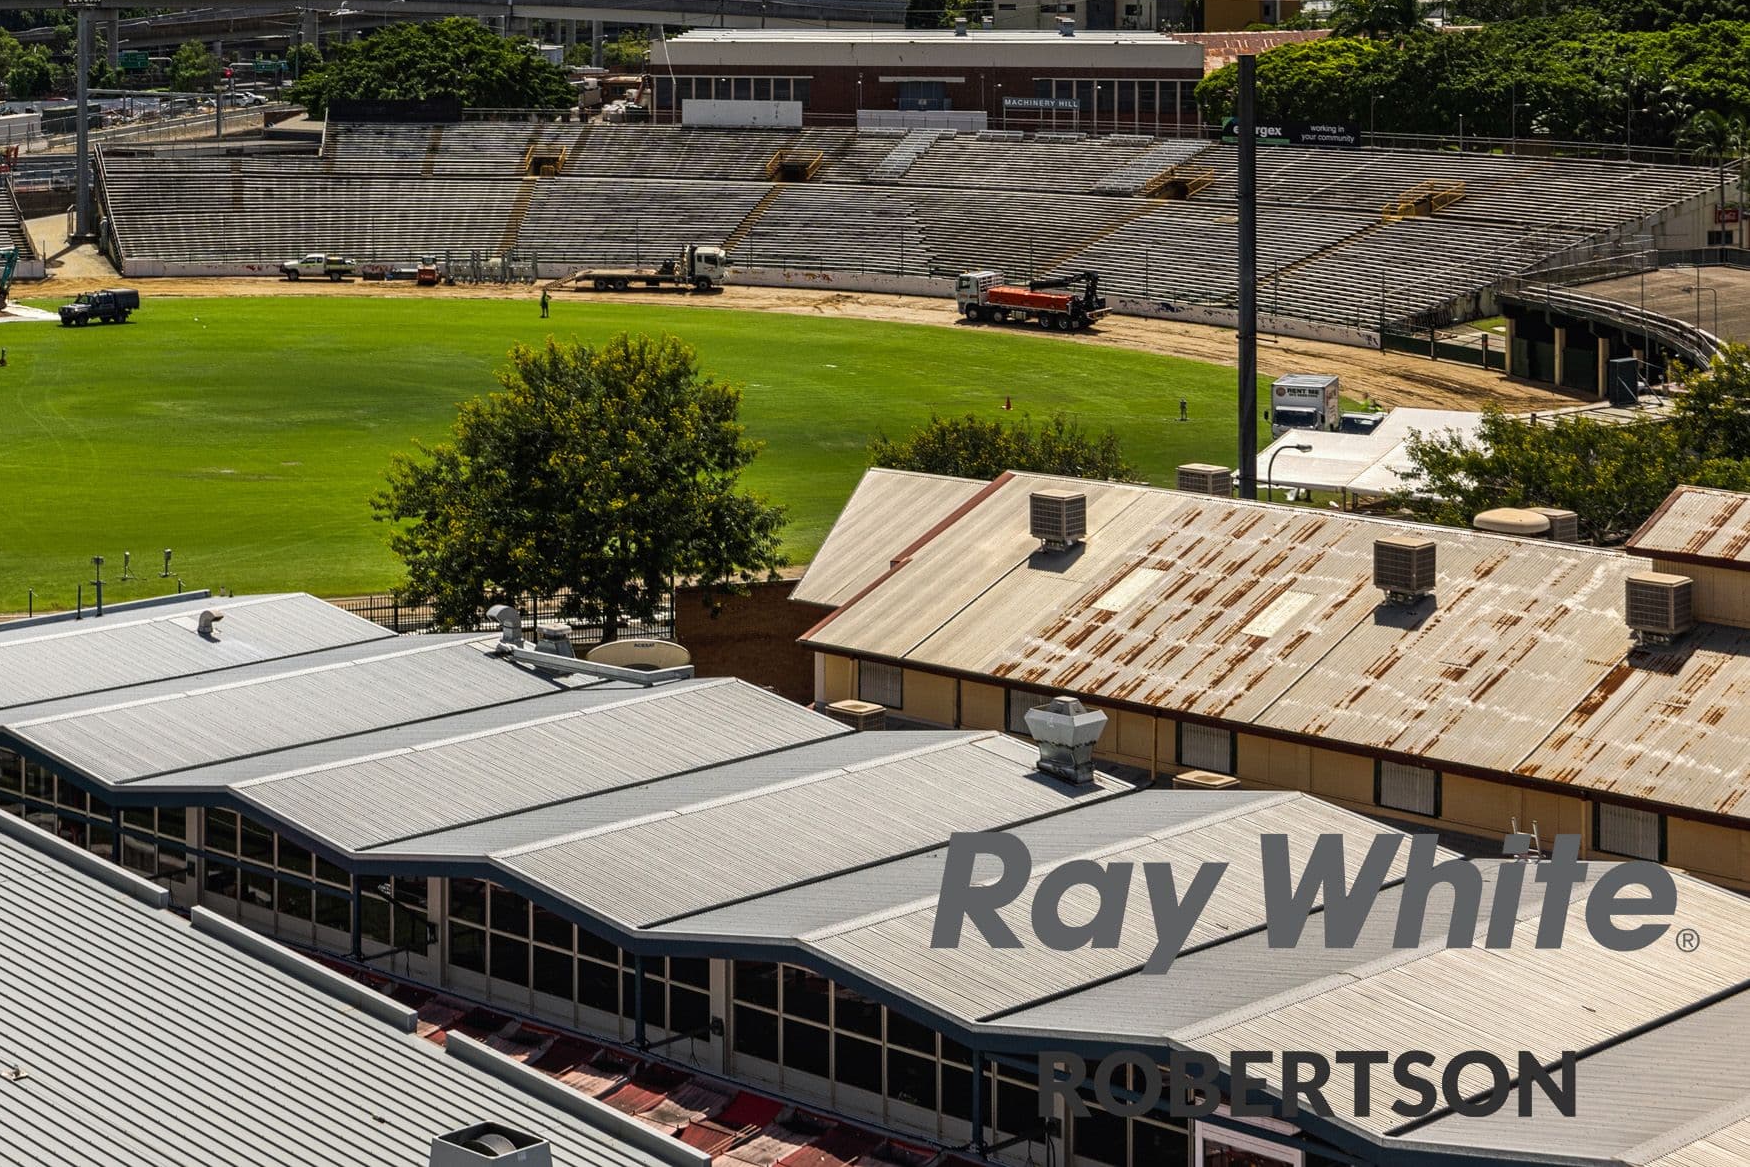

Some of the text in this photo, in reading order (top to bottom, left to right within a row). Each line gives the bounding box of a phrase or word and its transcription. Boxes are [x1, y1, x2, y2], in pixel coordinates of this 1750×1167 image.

[1004, 98, 1078, 108] MACHINERY HILL
[1233, 125, 1283, 137] ergex
[1310, 125, 1337, 134] working
[1301, 133, 1355, 143] your community
